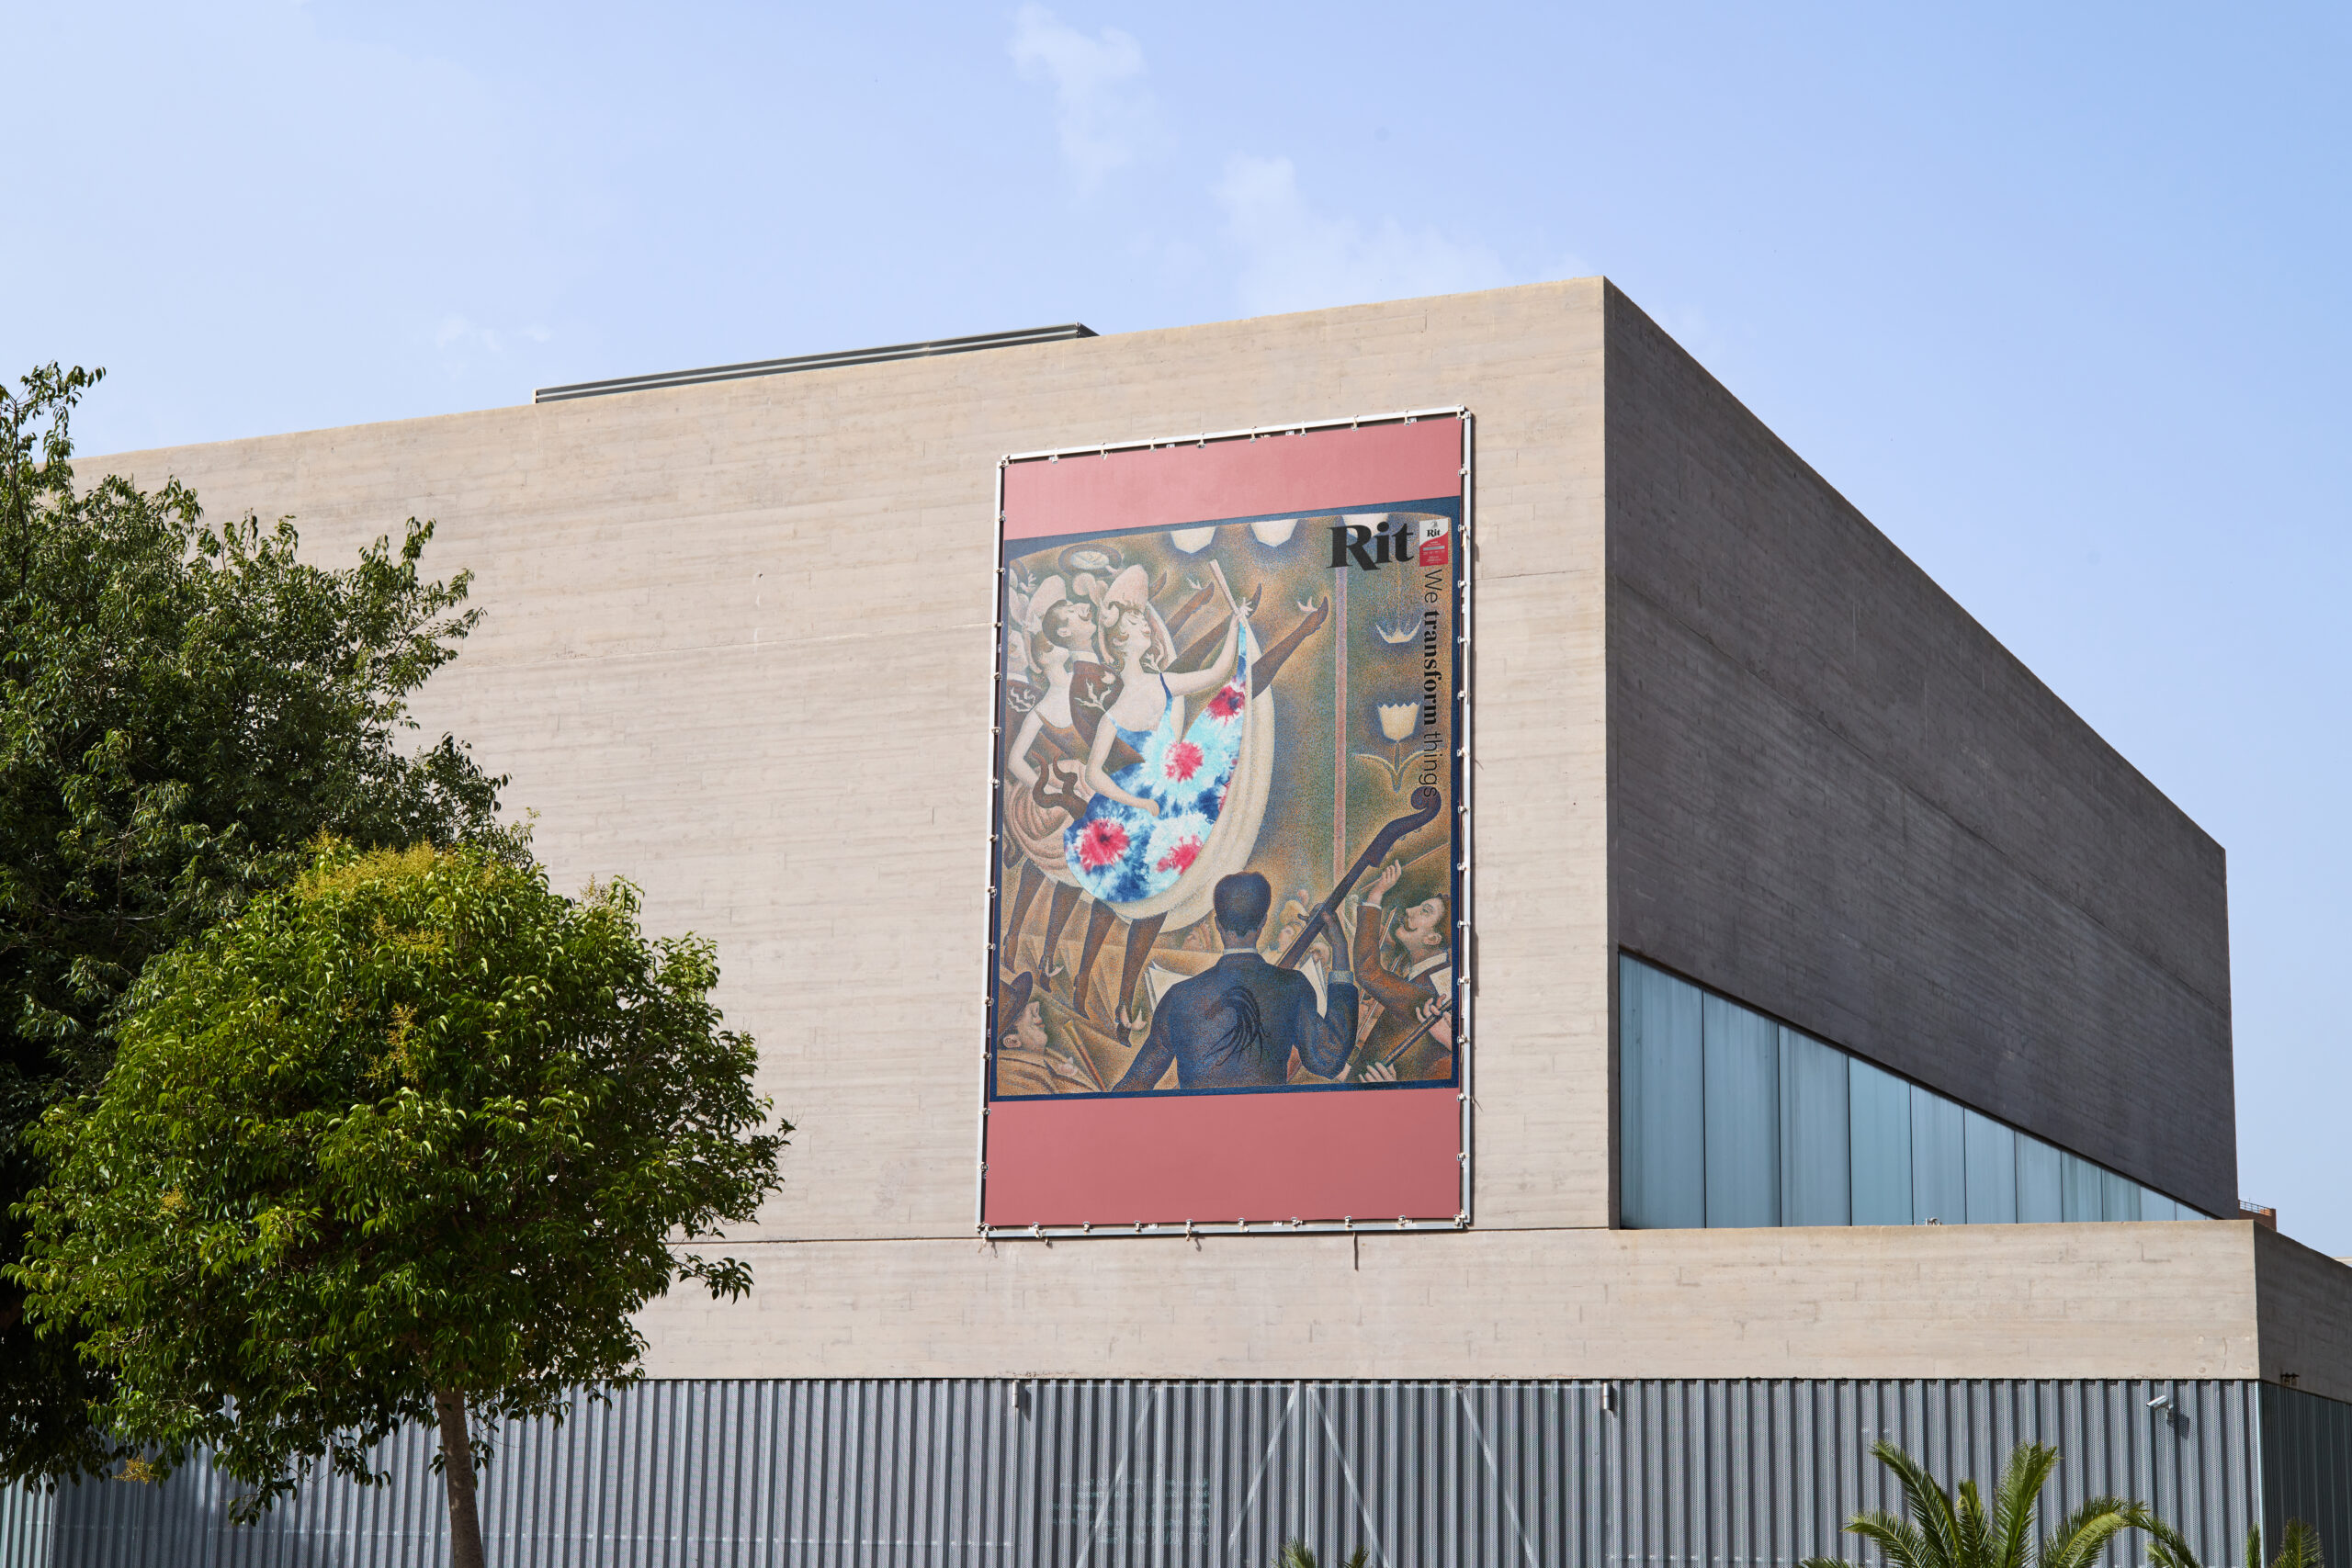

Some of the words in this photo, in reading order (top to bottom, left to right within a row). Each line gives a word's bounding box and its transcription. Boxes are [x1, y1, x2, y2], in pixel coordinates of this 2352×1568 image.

[1326, 522, 1414, 570] Rit
[1427, 529, 1441, 537] Rit
[1424, 569, 1442, 603] We
[1424, 610, 1442, 726] transform
[1419, 732, 1442, 797] things
